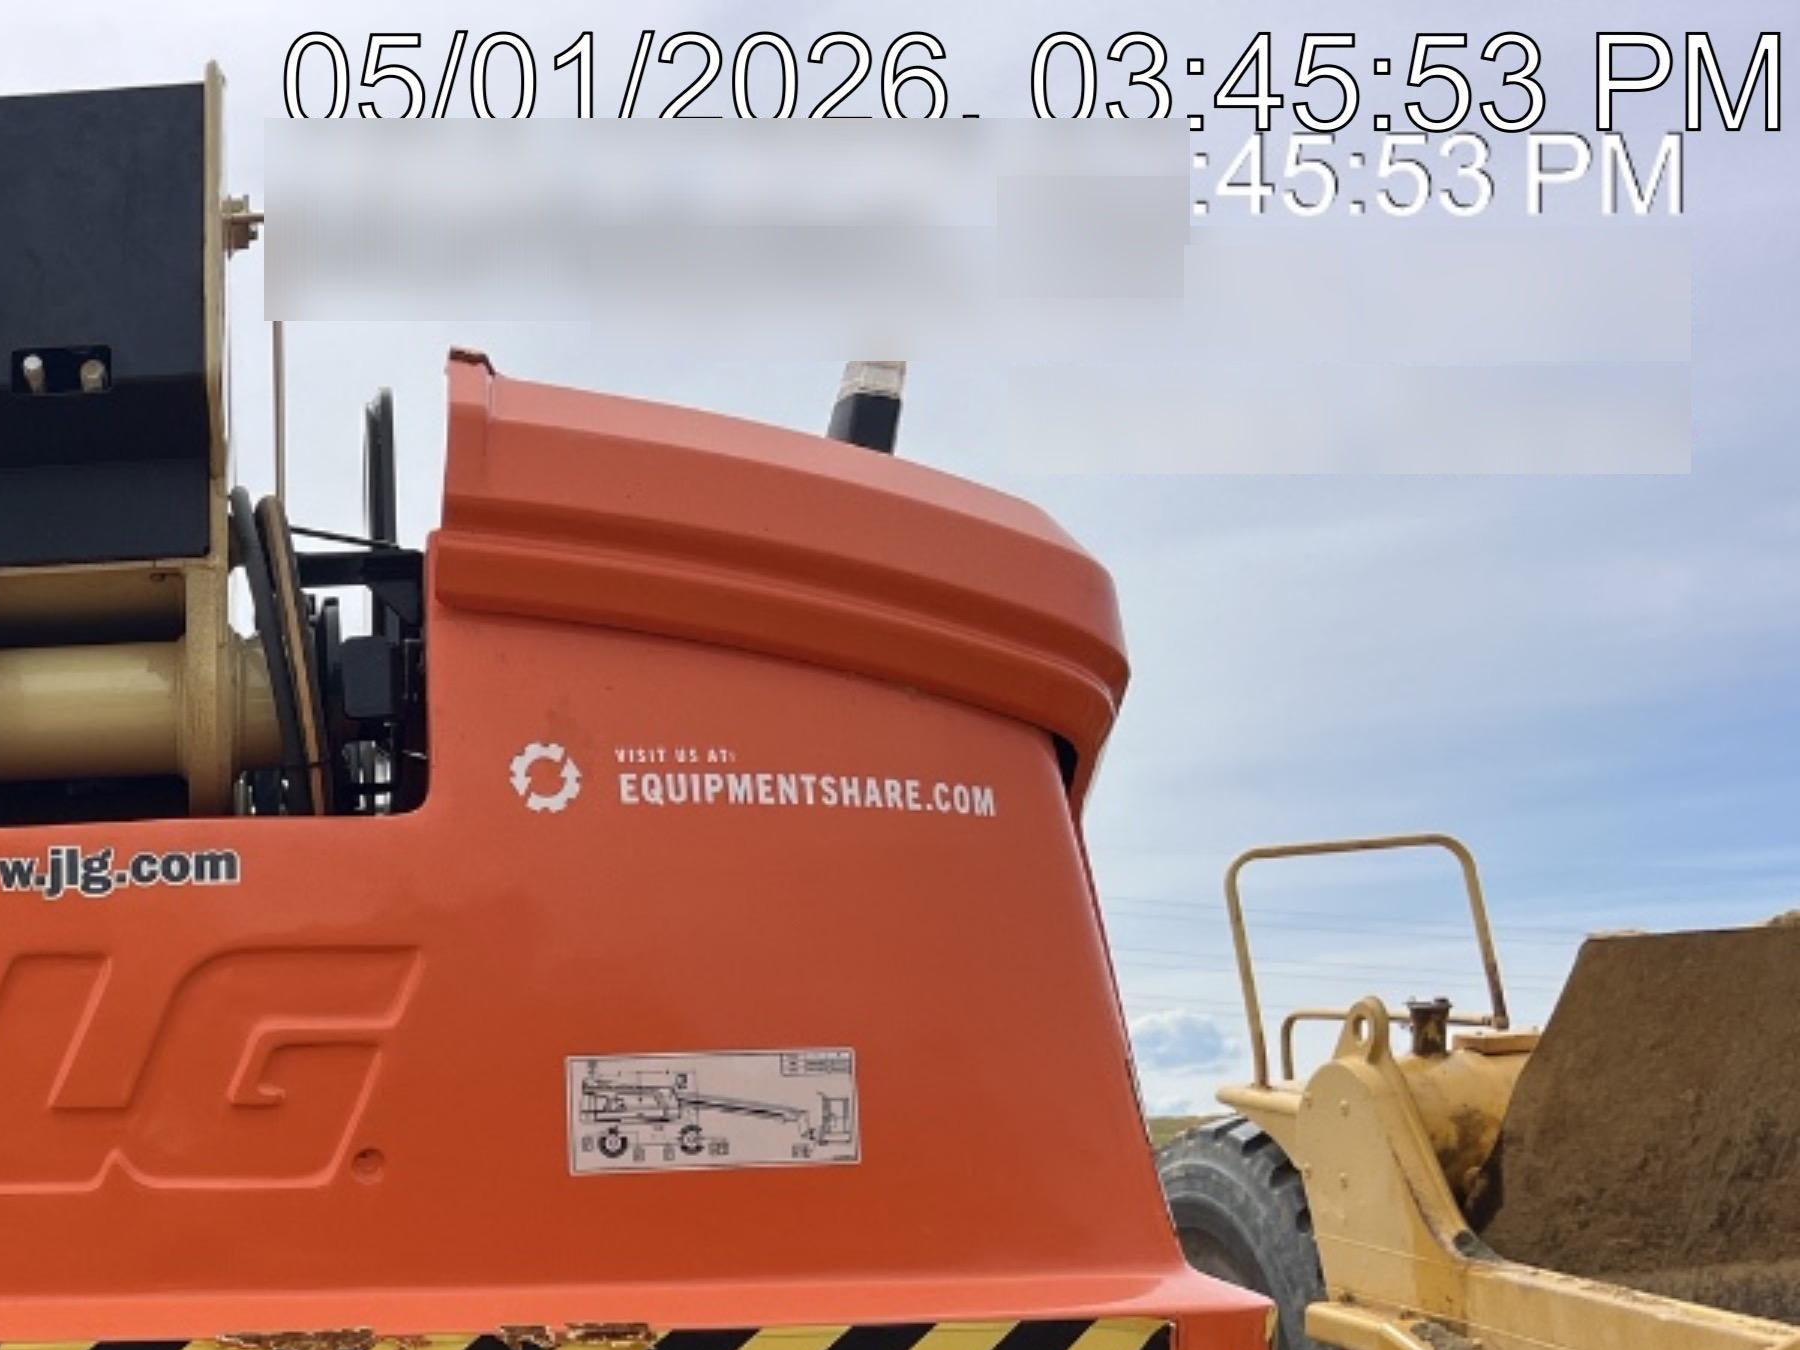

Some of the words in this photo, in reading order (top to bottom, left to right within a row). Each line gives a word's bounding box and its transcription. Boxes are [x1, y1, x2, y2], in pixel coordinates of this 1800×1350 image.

[614, 747, 667, 763] VISIT
[675, 747, 698, 763] US
[618, 772, 996, 817] EQUIPMENTSHARE.COM
